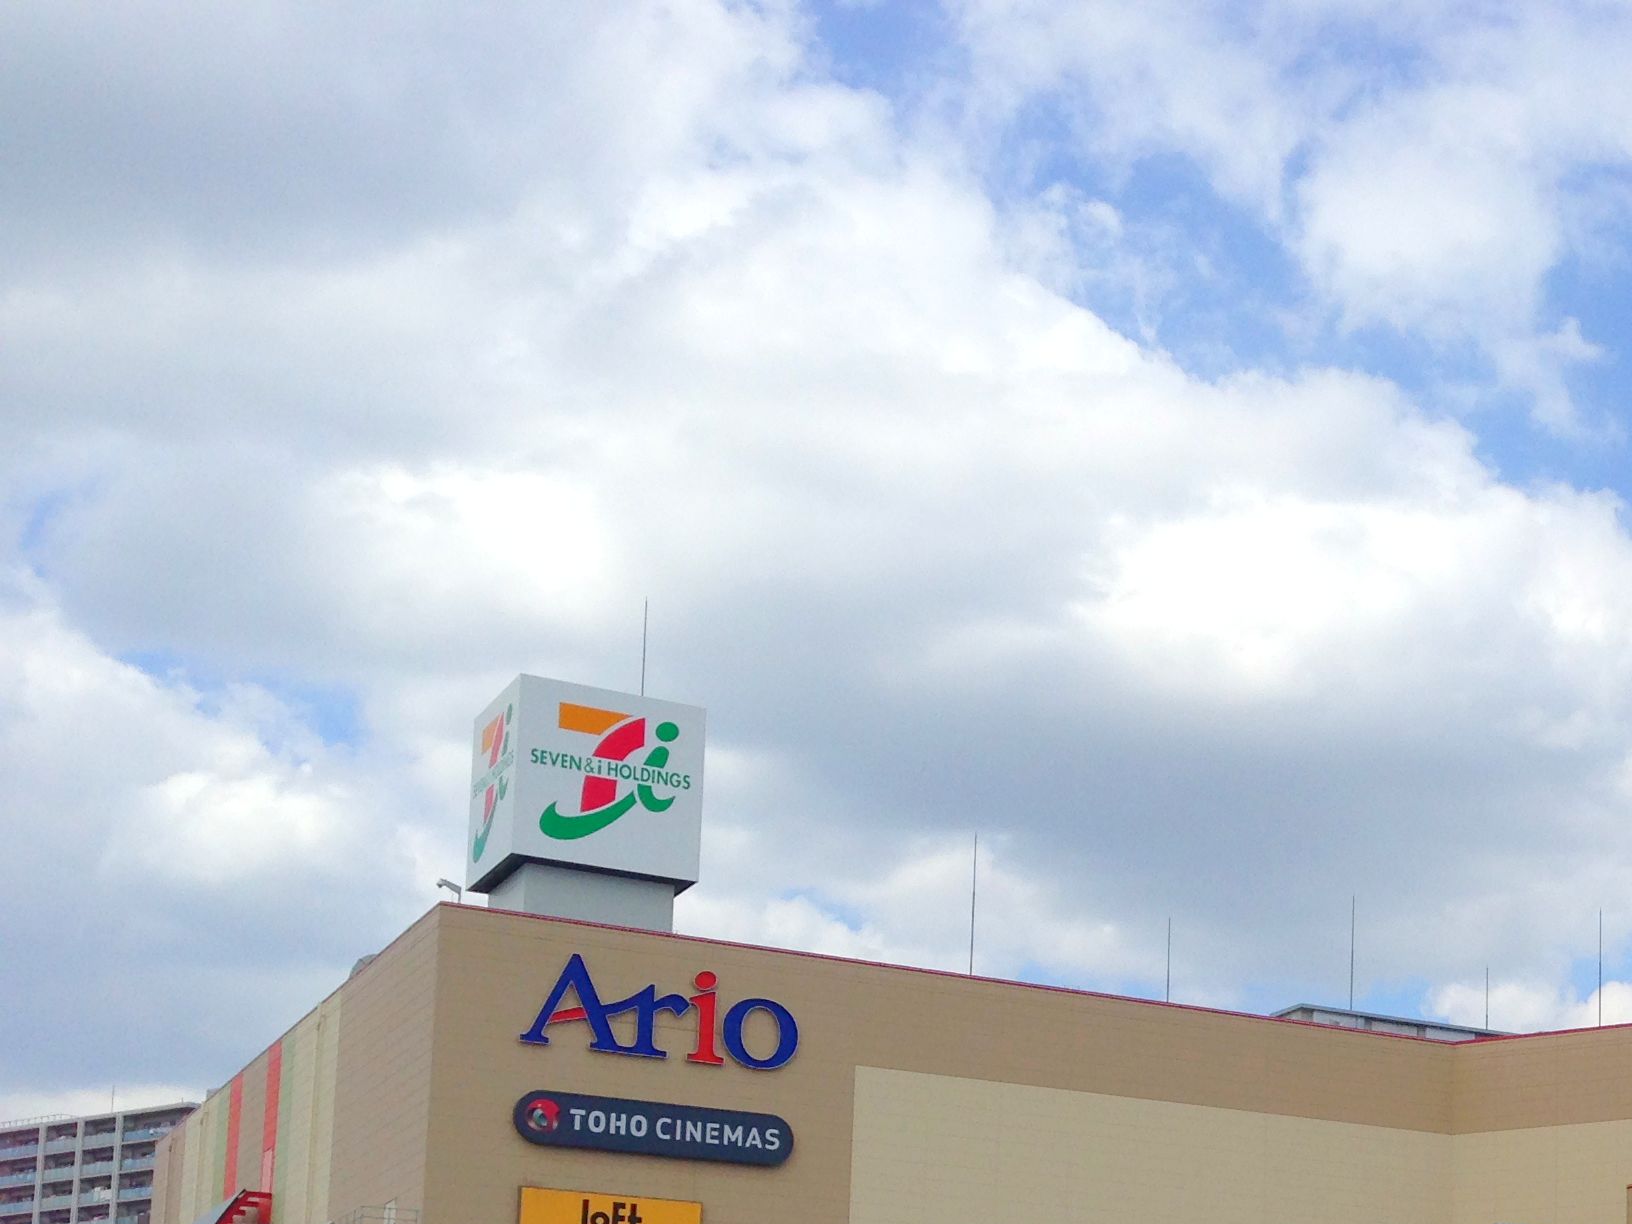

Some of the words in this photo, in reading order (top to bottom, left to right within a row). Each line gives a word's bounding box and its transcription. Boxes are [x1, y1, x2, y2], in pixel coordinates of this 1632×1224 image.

[606, 762, 692, 791] HOLDINGS
[518, 952, 800, 1070] Ario
[569, 1108, 648, 1137] TOHO
[655, 1117, 781, 1151] CINEMAS
